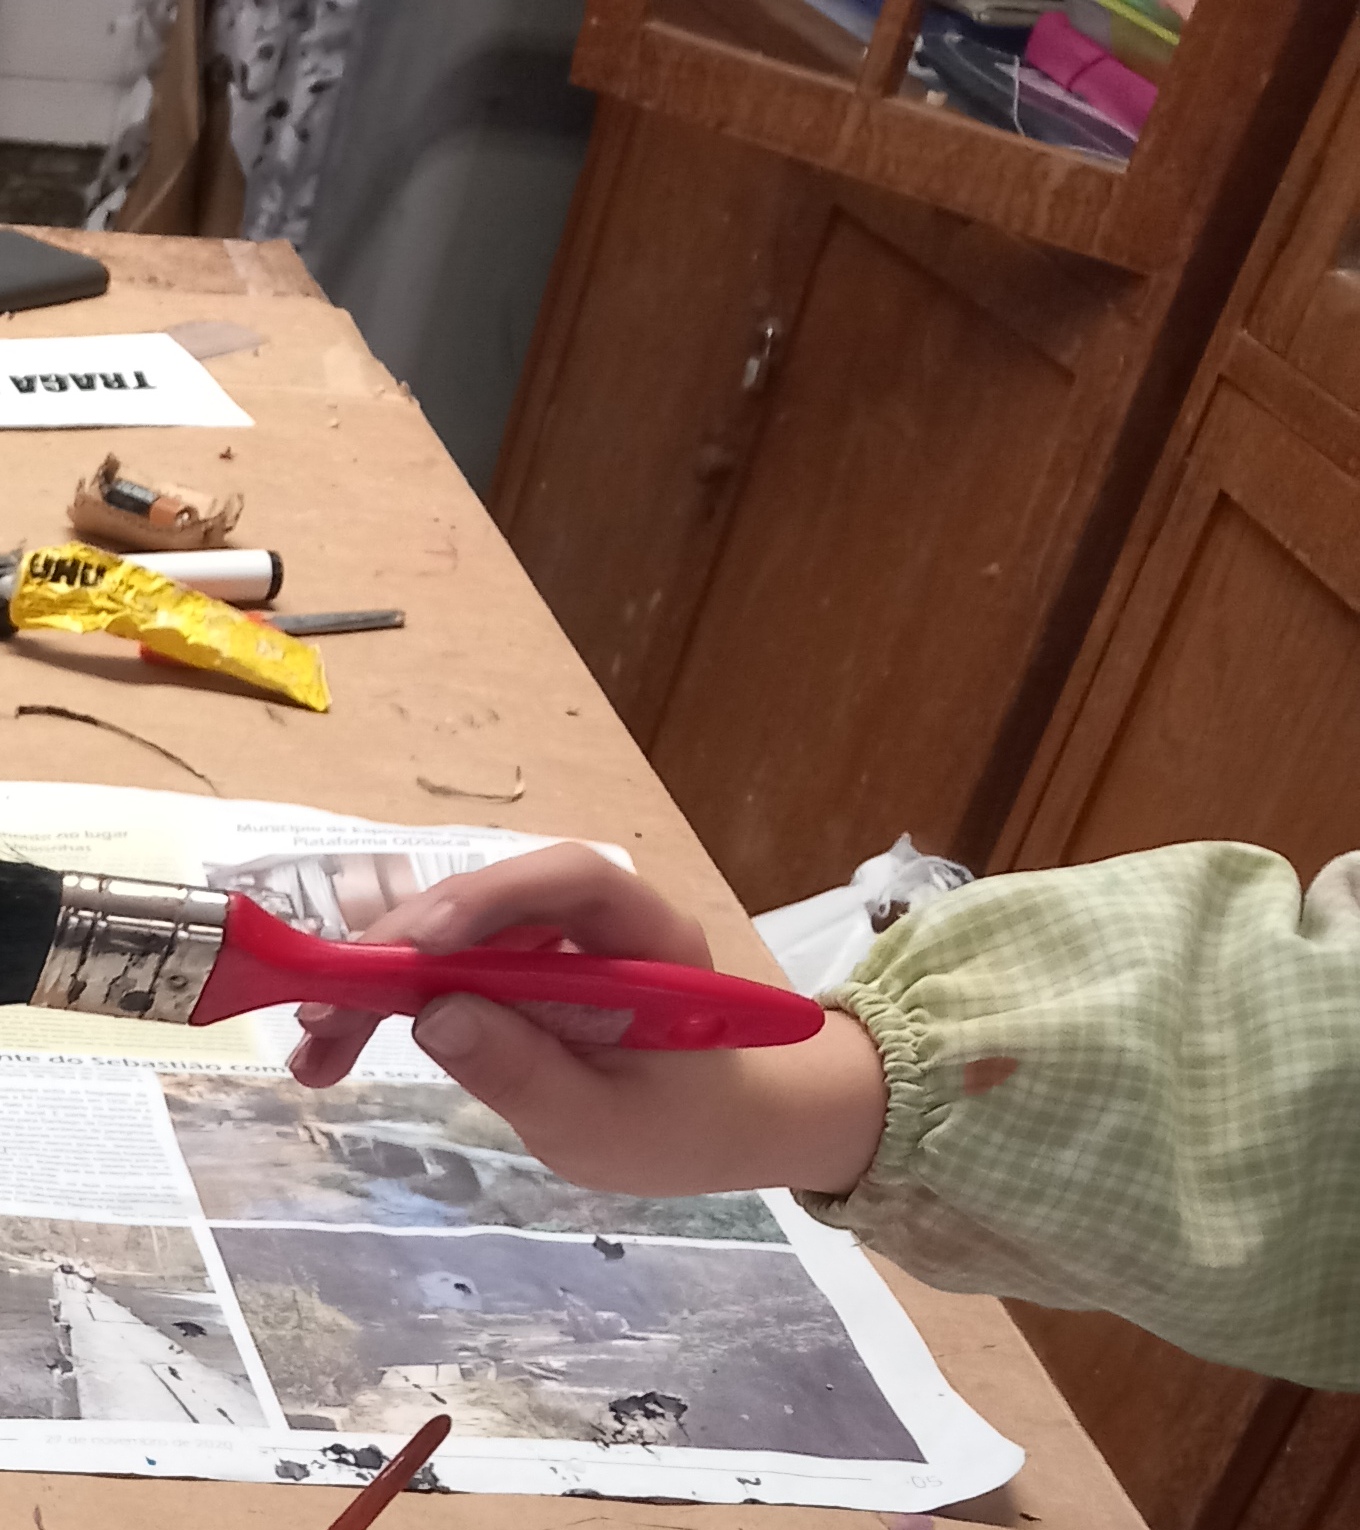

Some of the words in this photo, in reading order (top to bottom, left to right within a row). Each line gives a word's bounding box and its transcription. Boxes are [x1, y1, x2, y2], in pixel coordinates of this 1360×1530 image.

[9, 370, 156, 393] TRAGA
[49, 1053, 84, 1066] do
[91, 1055, 222, 1074] Sebastião
